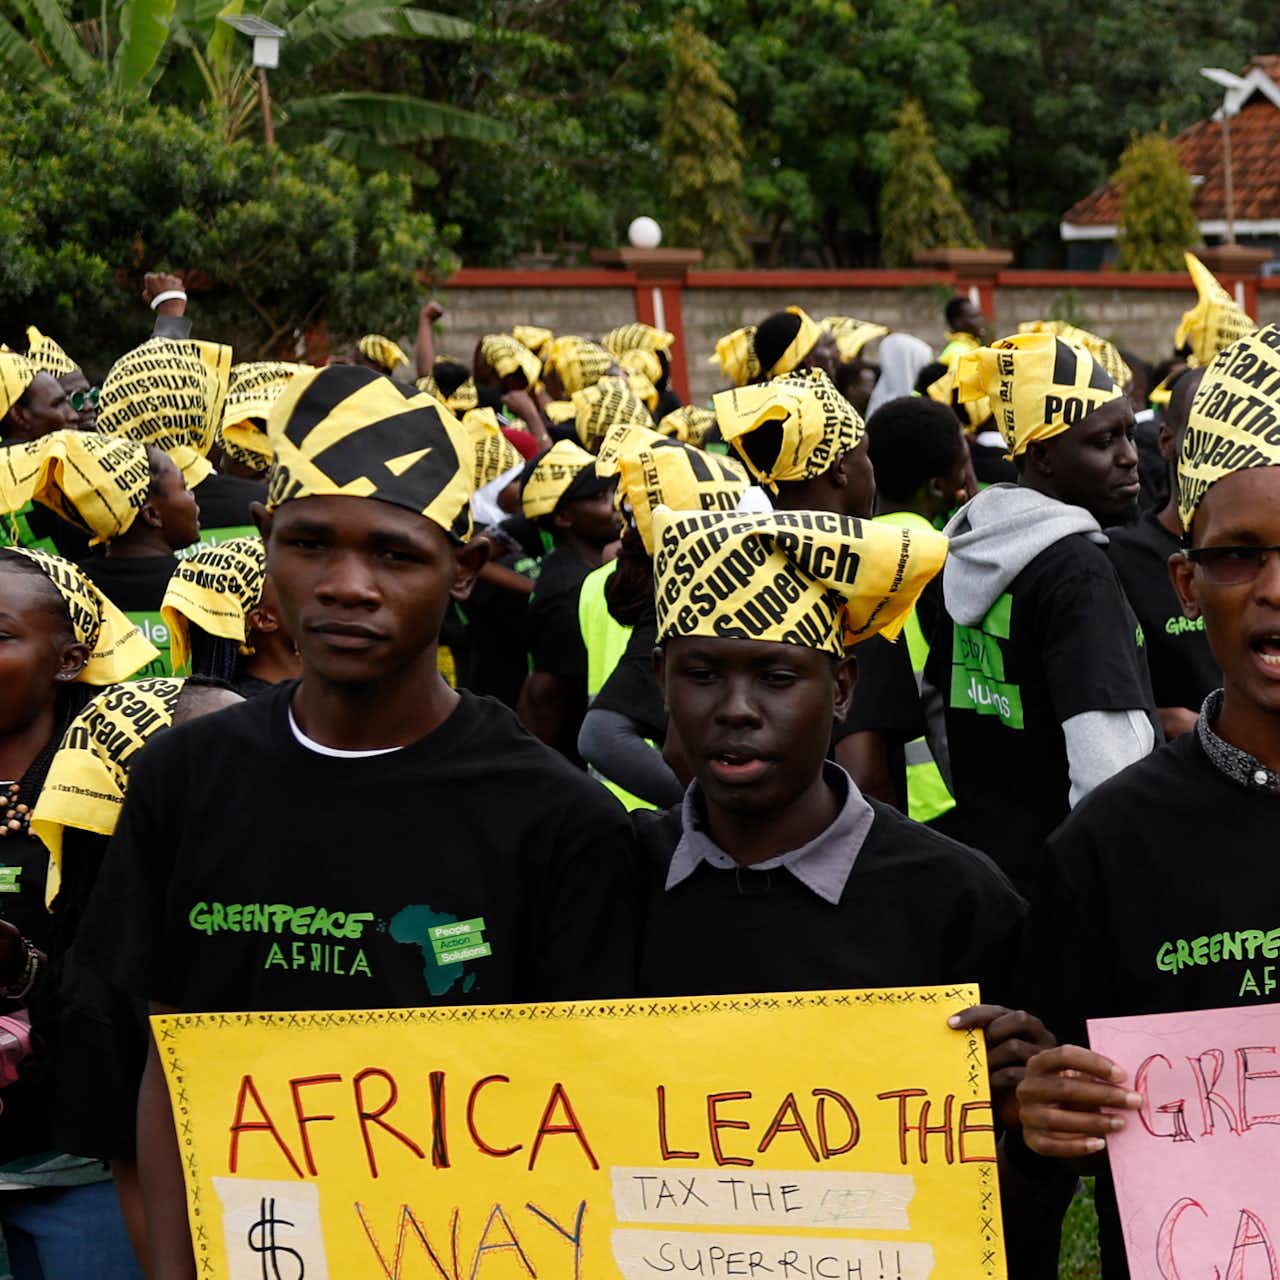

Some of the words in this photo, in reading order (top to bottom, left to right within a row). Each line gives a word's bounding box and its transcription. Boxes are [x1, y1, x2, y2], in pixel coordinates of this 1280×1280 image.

[189, 902, 374, 939] GREENPEACE
[434, 922, 472, 938] People
[265, 942, 372, 977] AFRICA
[441, 945, 487, 963] Solutions
[229, 1066, 600, 1179] AFRICA
[656, 1084, 861, 1167] LEAD
[876, 1087, 998, 1166] THE
[632, 1174, 709, 1211] TAX
[717, 1178, 804, 1214] THE
